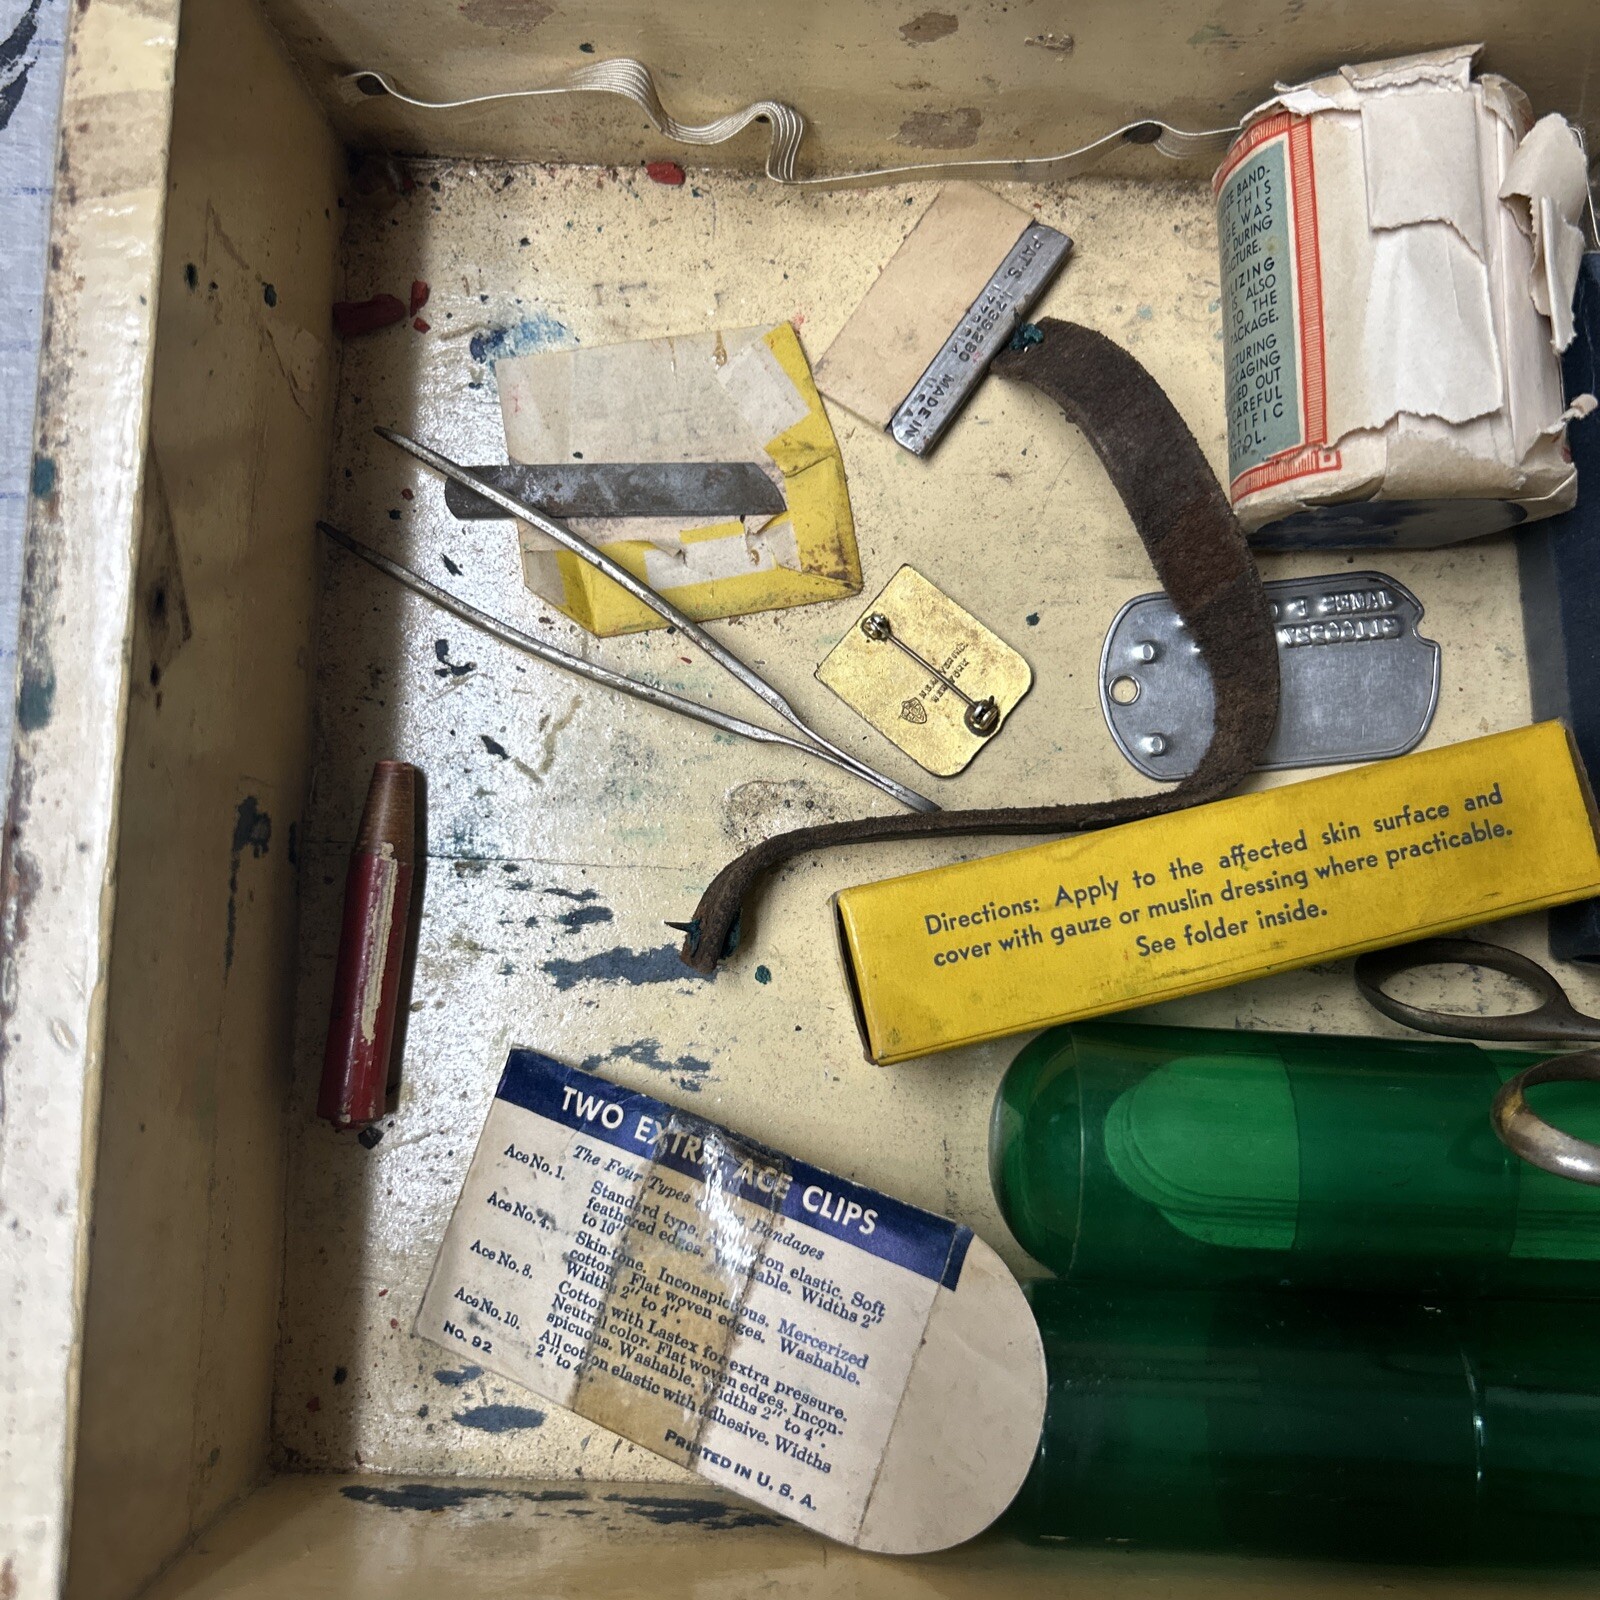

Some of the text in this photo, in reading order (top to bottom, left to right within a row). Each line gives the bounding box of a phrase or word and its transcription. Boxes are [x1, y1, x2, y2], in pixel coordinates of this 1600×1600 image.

[1236, 165, 1271, 197] BAND-
[1236, 179, 1272, 212] THIS
[1233, 215, 1273, 252] DURING
[1240, 197, 1273, 225] WAS
[1232, 309, 1244, 327] TO
[1252, 290, 1278, 313] THE
[1245, 273, 1277, 301] ALSO
[1256, 366, 1281, 389] OUT
[905, 373, 955, 437] MADE IN
[1231, 385, 1282, 424] CAREFUL
[924, 782, 1503, 935] Directions: Apply to the affected skin surface and
[933, 819, 1513, 967] cover with gauze or muslin dressing where practicable.
[1135, 898, 1328, 957] See folder inside.
[503, 1143, 565, 1181] Ace No. 1.
[561, 1085, 624, 1130] TWO
[634, 1115, 715, 1166] EXTR
[732, 1158, 793, 1200] ACE
[802, 1184, 879, 1235] CLIPS
[487, 1190, 551, 1231] Ace No. 4.
[572, 1144, 601, 1167] The
[604, 1157, 644, 1184] Four
[648, 1174, 692, 1204] Types
[751, 1217, 825, 1261] Bandages
[582, 1211, 598, 1229] to
[470, 1239, 533, 1279] Ace No. 8.
[586, 1197, 657, 1236] feathered
[801, 1285, 858, 1324] Widths
[590, 1180, 661, 1219] Standard
[789, 1266, 843, 1301] elastic.
[850, 1289, 886, 1318] Soft
[454, 1286, 521, 1331] Ace No. 10.
[565, 1260, 617, 1295] Widths
[641, 1294, 658, 1312] to
[575, 1230, 647, 1274] Skin-tone.
[777, 1317, 870, 1371] Mercerized
[471, 1335, 493, 1355] 92
[558, 1280, 848, 1423] Cotton with Lastex for extra pressure.
[628, 1271, 660, 1296] Flat
[665, 1289, 713, 1321] woven
[717, 1311, 766, 1345] edges.
[780, 1336, 861, 1387] Washable.
[546, 1311, 613, 1351] spicuous.
[619, 1339, 695, 1389] Washable.
[784, 1418, 801, 1435] to
[551, 1292, 844, 1436] Neutral color. Flat woven edges. Incon-
[556, 1354, 572, 1370] to
[539, 1329, 563, 1350] All
[611, 1363, 661, 1395] elastic
[663, 1387, 697, 1412] with
[699, 1404, 770, 1446] adhesive.
[775, 1433, 832, 1474] Widths
[664, 1428, 817, 1512] PRINTED IN U. S. A.
